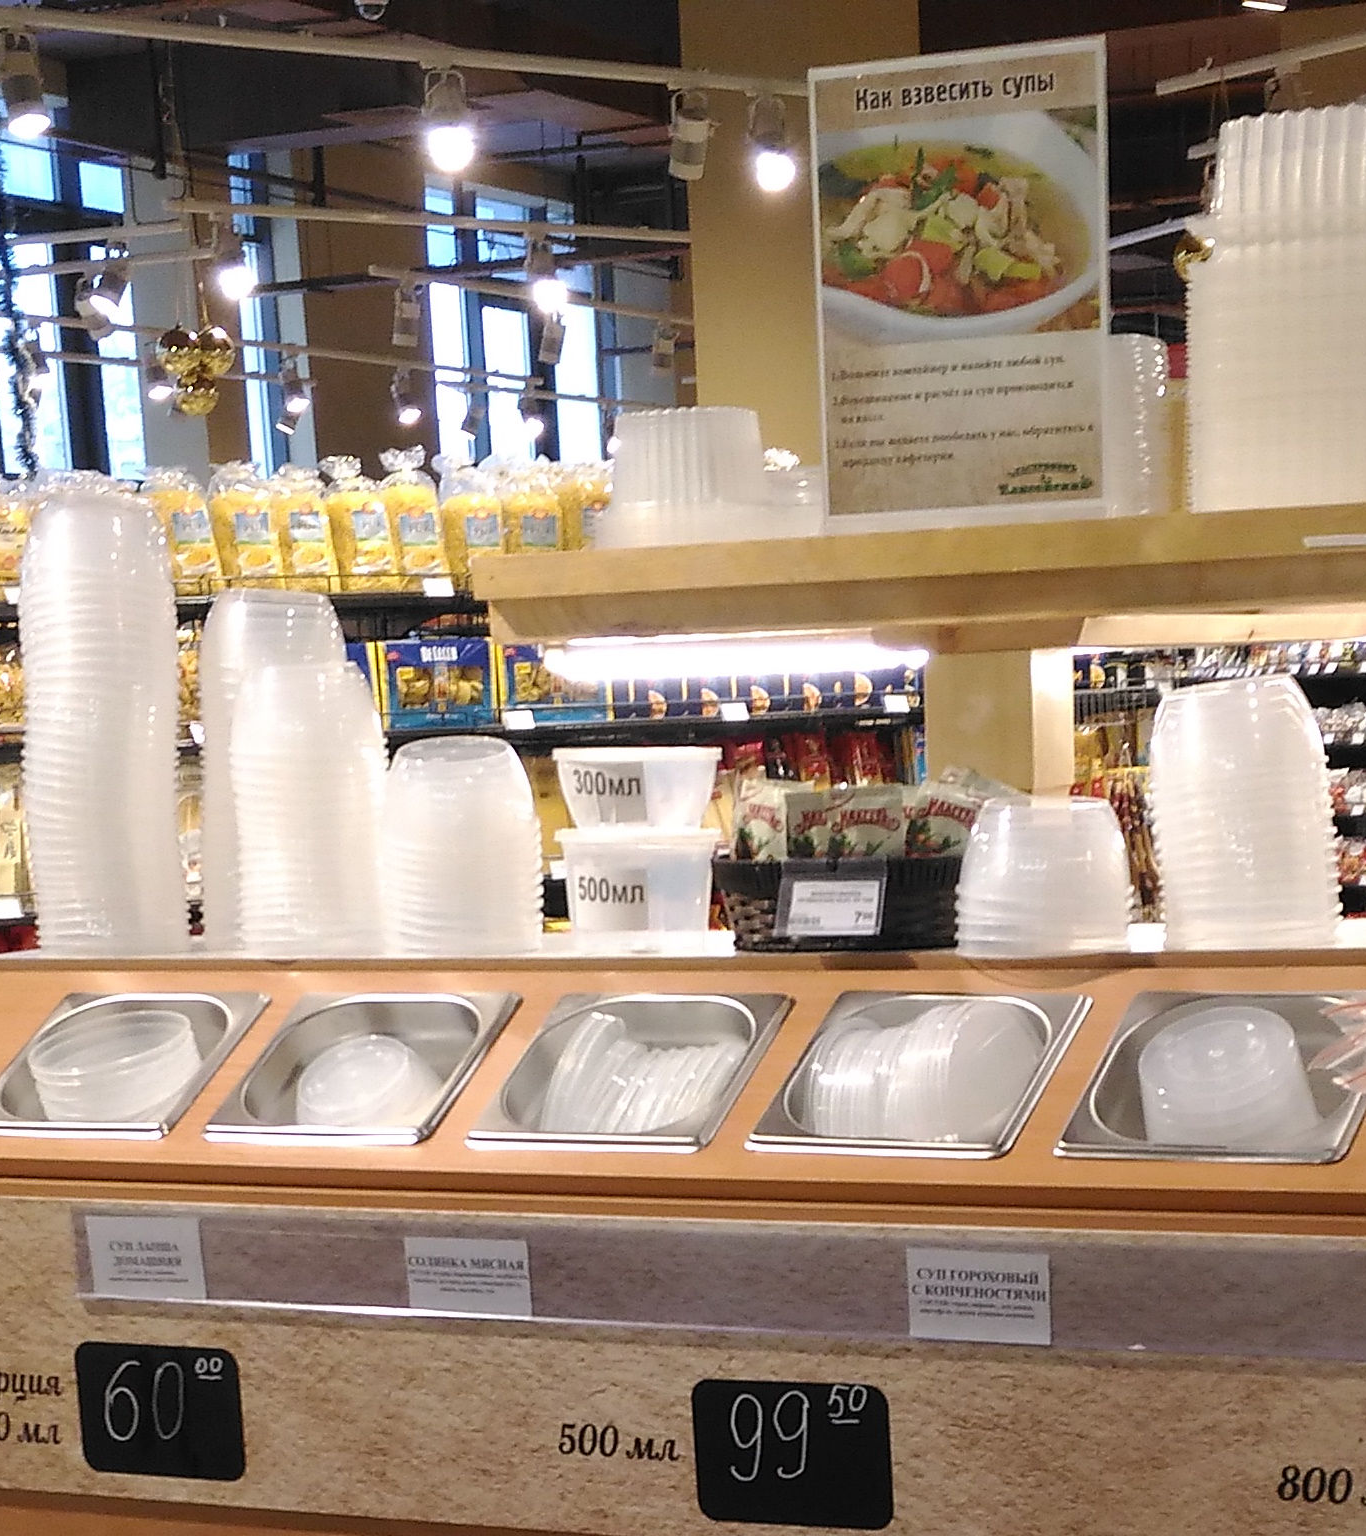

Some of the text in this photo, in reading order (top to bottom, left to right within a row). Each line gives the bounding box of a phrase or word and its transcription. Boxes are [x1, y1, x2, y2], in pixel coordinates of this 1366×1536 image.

[856, 73, 1054, 111] Как взвесить супы
[572, 769, 642, 797] 300мл
[578, 875, 645, 904] 500мл
[916, 1267, 1039, 1285] СУП ГОРОХОВЫЙ
[911, 1284, 1047, 1302] С КОПЧЕНОСТЯМИ
[104, 1360, 185, 1442] 60
[16, 1421, 62, 1446] мл
[557, 1423, 681, 1461] 500 мл
[729, 1384, 868, 1482] 99 50
[1276, 1464, 1353, 1505] 800
